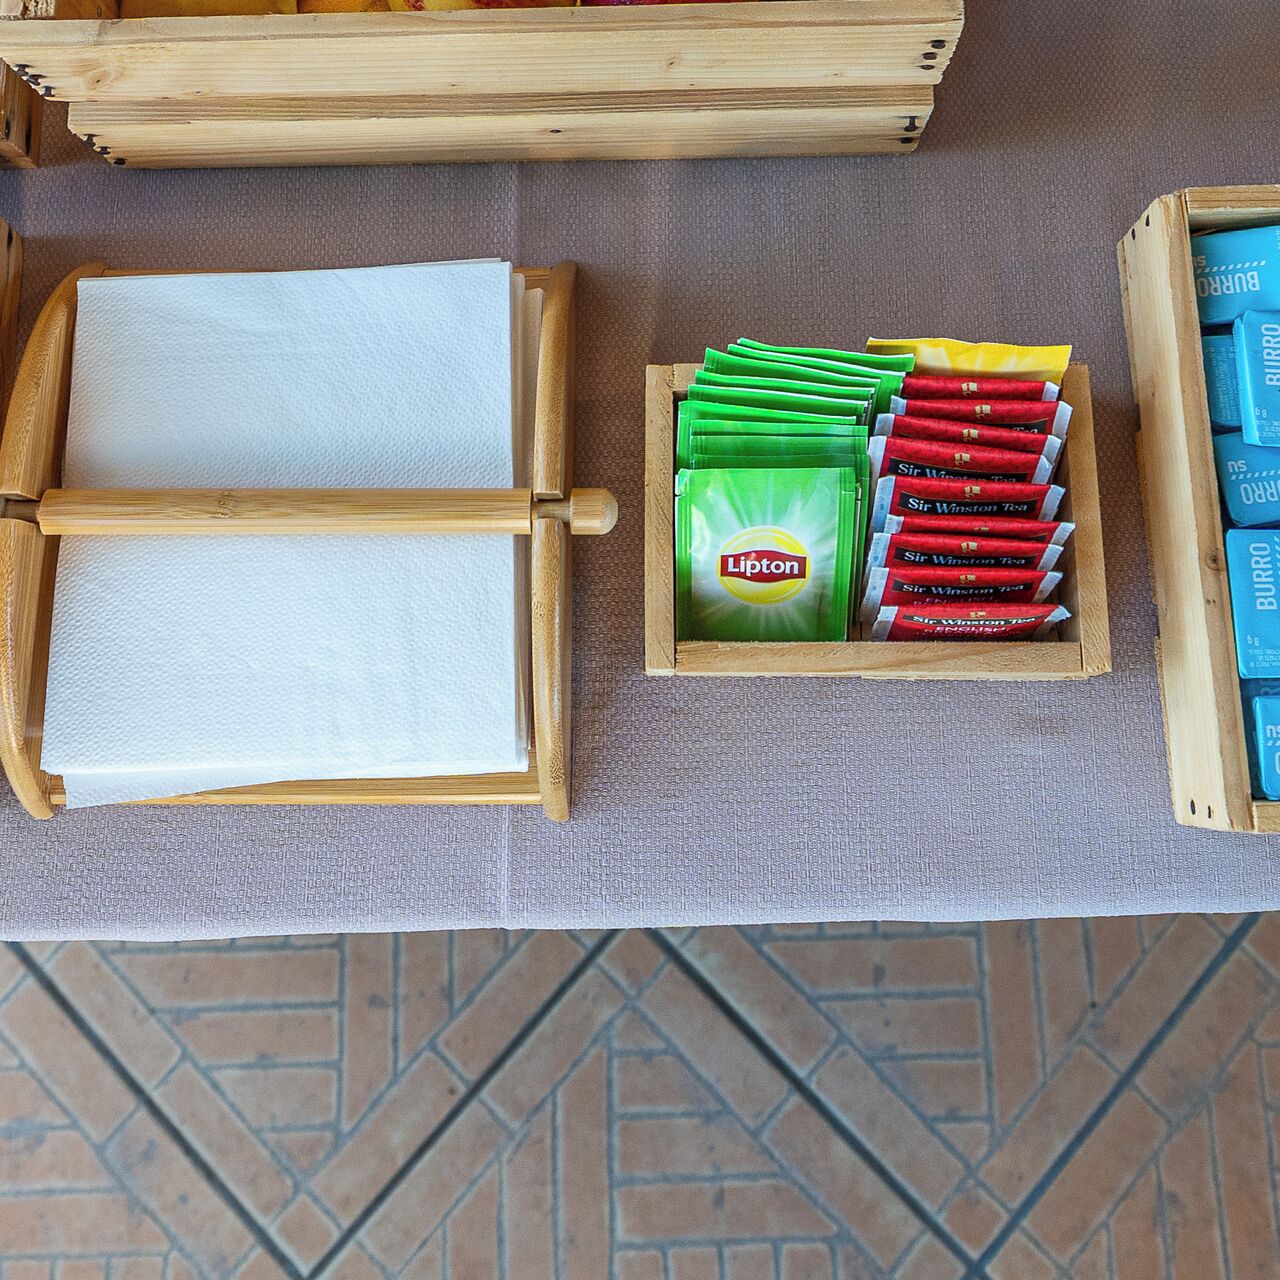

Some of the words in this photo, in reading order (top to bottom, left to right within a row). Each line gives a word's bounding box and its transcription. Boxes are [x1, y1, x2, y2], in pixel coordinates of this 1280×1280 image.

[1197, 271, 1260, 297] BURRO
[908, 497, 932, 511] Sir
[937, 502, 998, 514] Winston
[1002, 503, 1028, 512] Tea
[728, 556, 799, 577] Lipton
[904, 551, 928, 562] Sir
[932, 555, 995, 566] Winston
[1250, 542, 1278, 611] BURRO
[902, 584, 927, 593] Sir
[931, 586, 994, 596] Winston
[913, 616, 937, 625] Sir
[942, 618, 1005, 626] Winston
[1009, 616, 1035, 624] Tea
